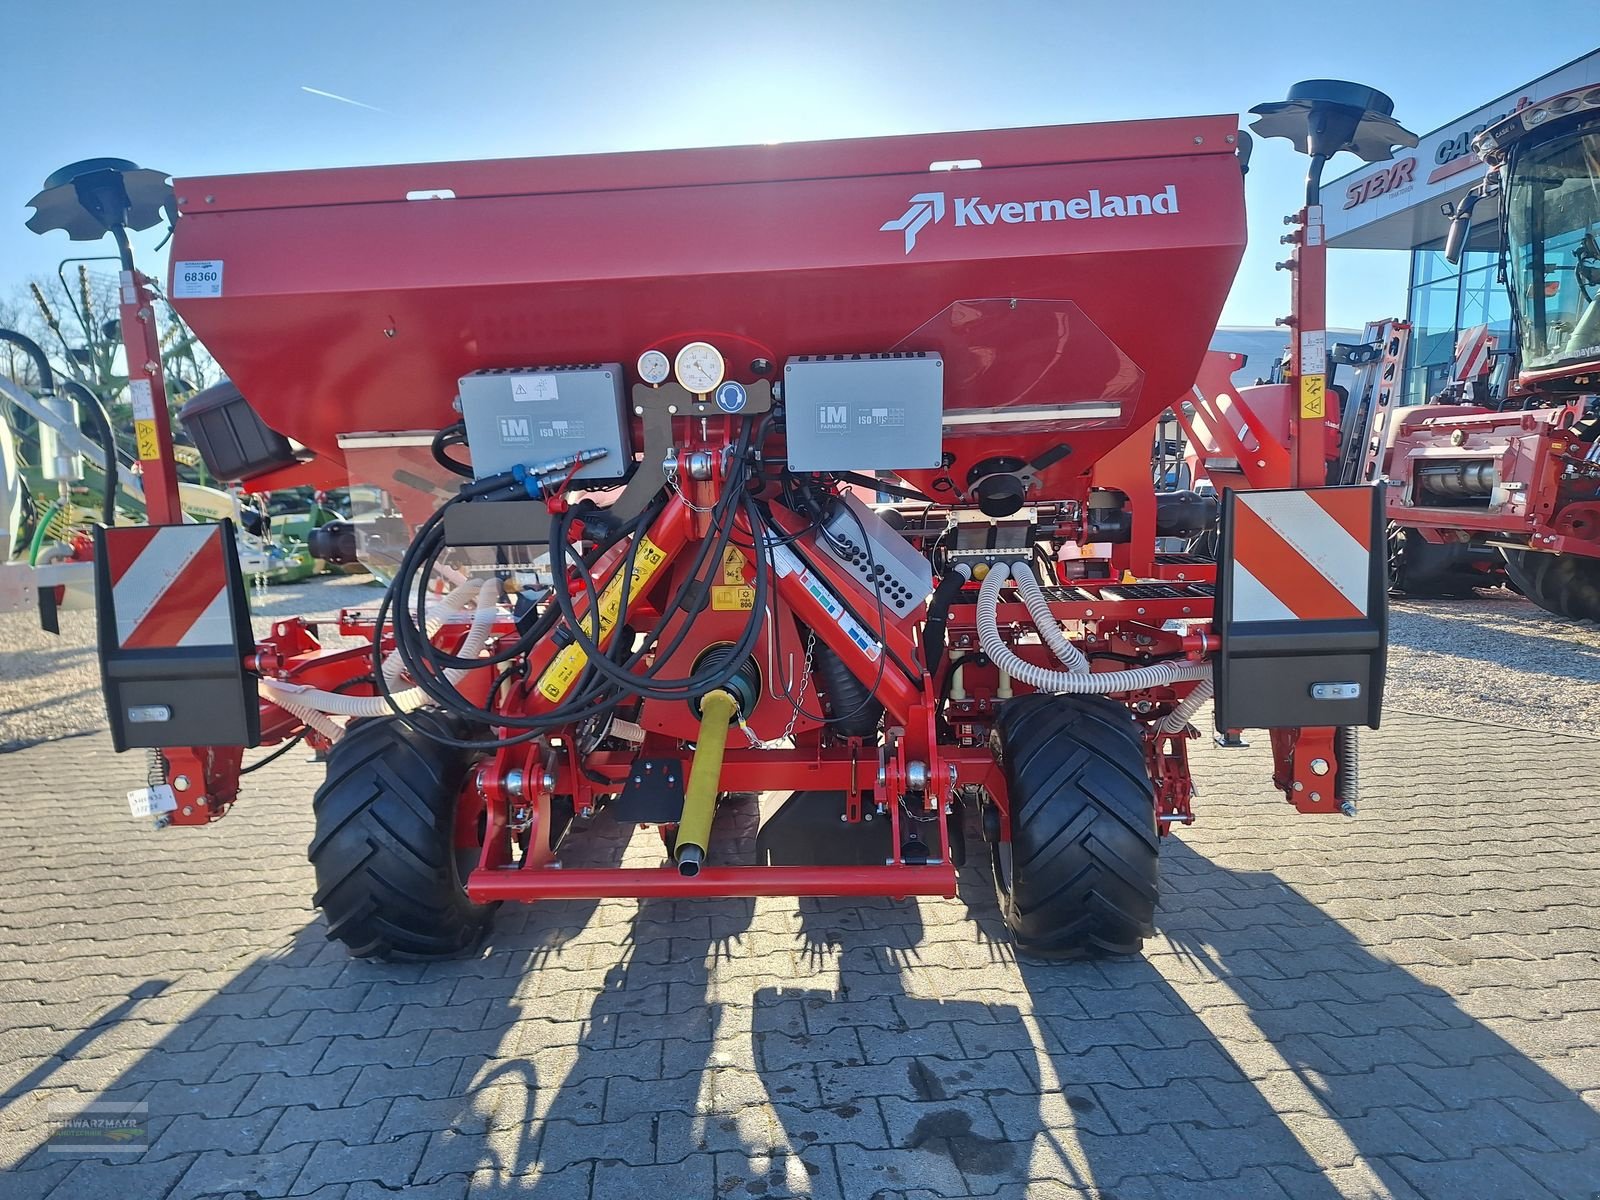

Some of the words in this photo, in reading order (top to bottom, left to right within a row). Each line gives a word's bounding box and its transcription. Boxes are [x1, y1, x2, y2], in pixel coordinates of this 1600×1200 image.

[1343, 157, 1416, 210] STEYR
[953, 184, 1180, 227] Kverneland
[184, 271, 218, 282] 68360
[820, 406, 847, 423] iM
